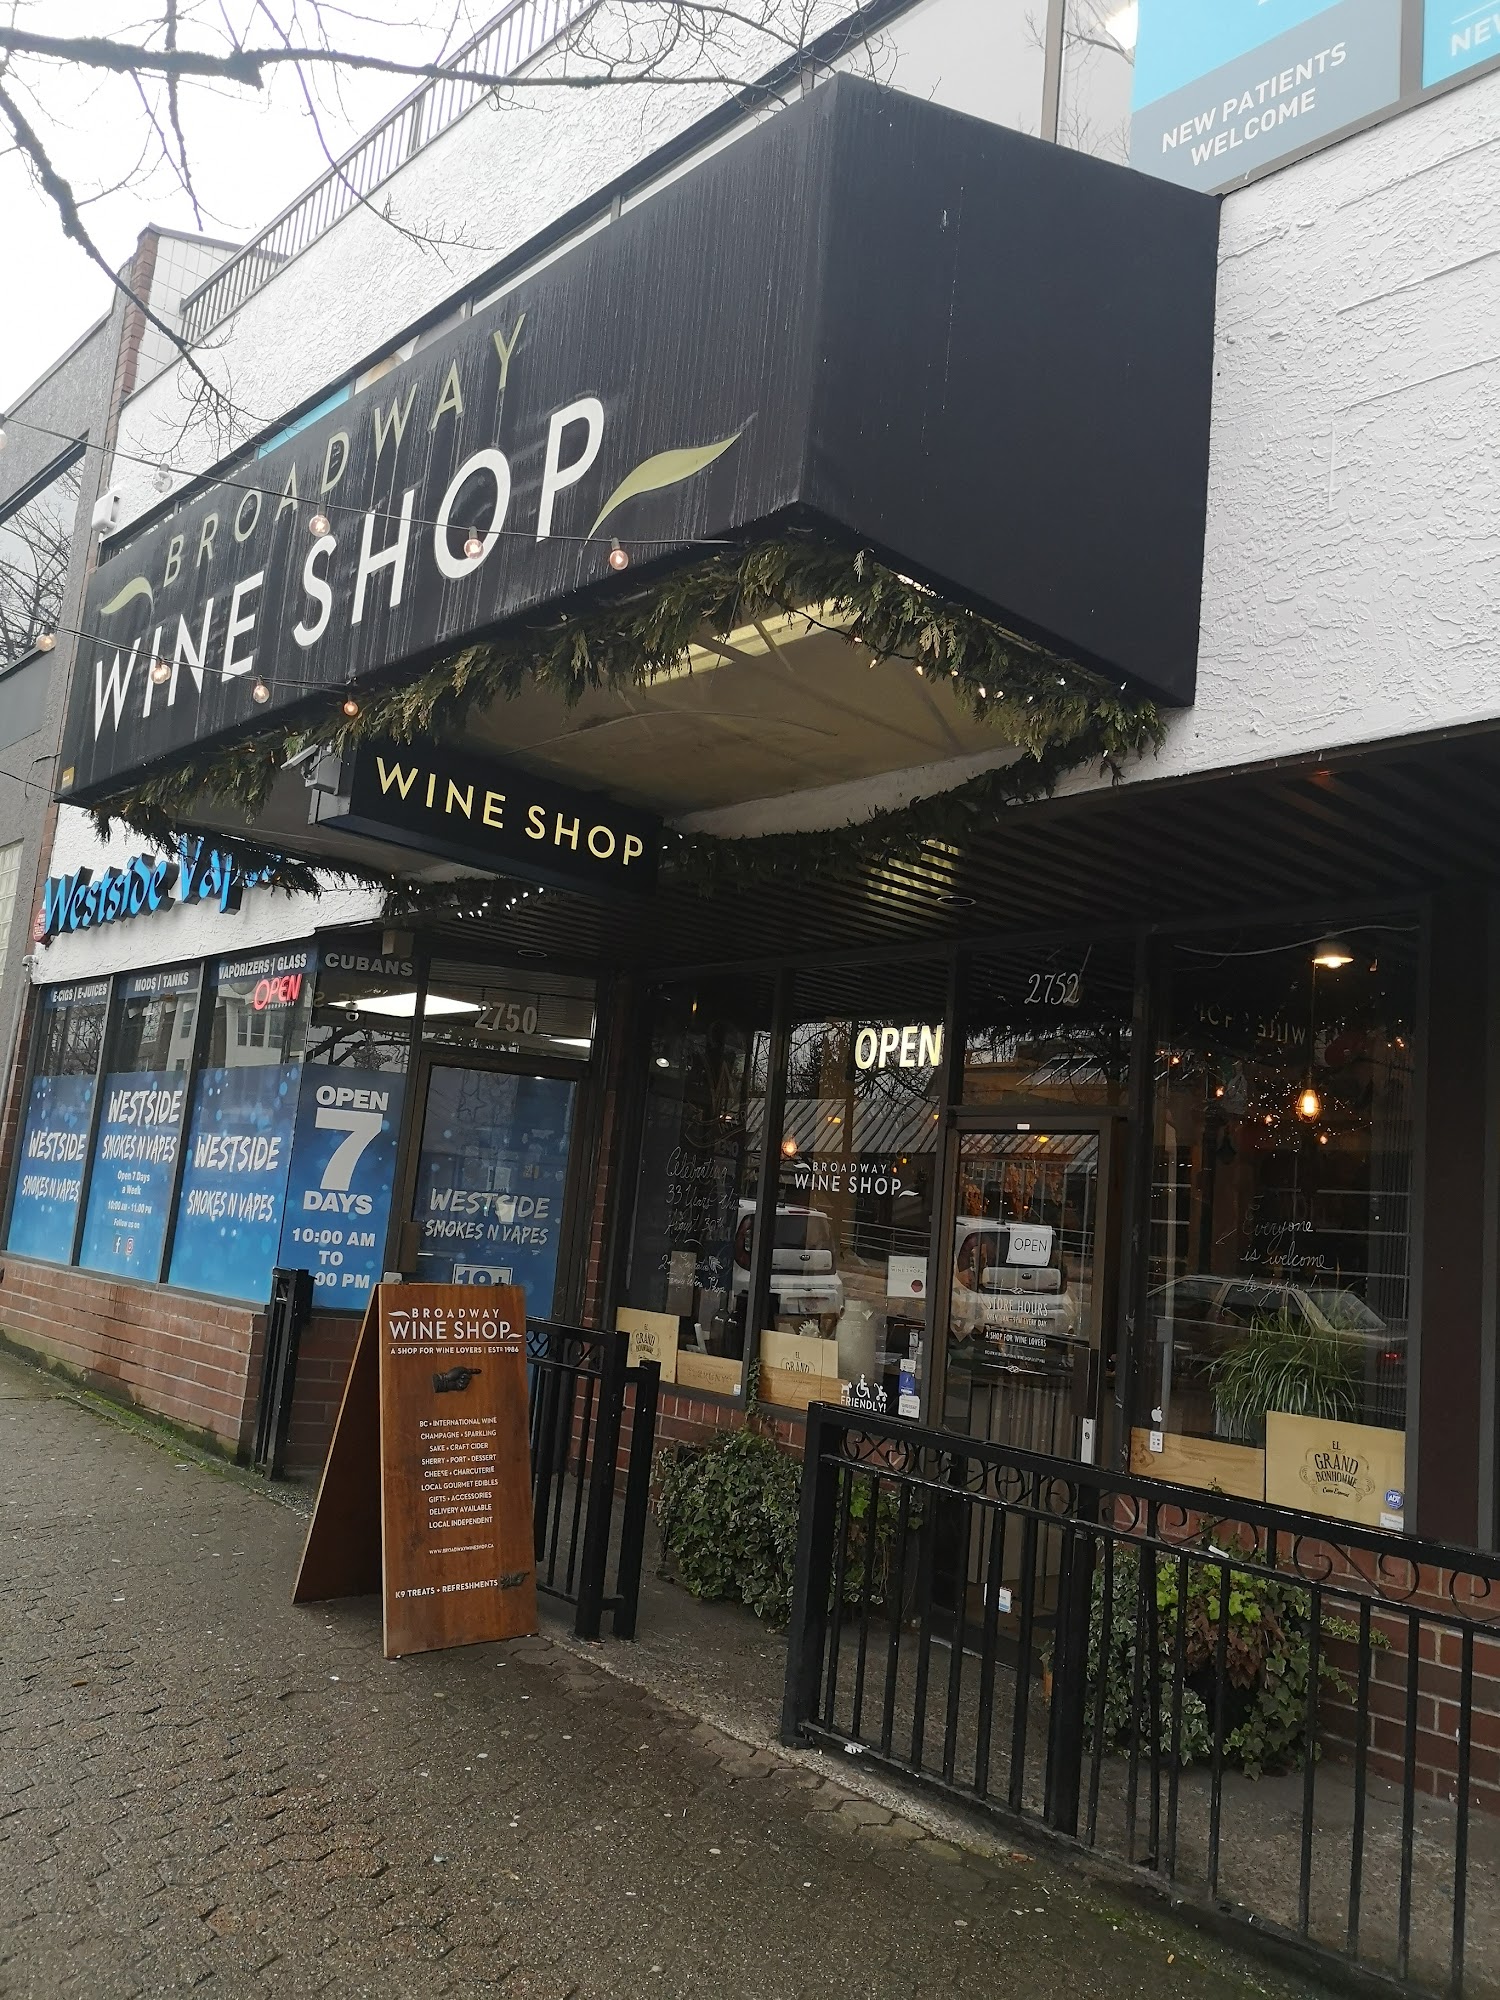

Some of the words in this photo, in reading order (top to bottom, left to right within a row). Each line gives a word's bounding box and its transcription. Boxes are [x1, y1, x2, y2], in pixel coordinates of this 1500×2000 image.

[1161, 108, 1217, 153] NEW
[1222, 42, 1347, 124] PATIENTS
[1190, 88, 1317, 166] WELCOME
[163, 313, 526, 589] BROADWAY
[94, 571, 265, 742] WINE
[293, 397, 605, 647] SHOP
[376, 757, 506, 829] WINE
[525, 805, 644, 865] SHOP
[44, 854, 170, 934] Westside
[219, 959, 270, 979] VAPORIZERS
[277, 953, 307, 971] GLASS
[325, 952, 413, 977] CUBANS
[135, 976, 156, 993] MODS
[163, 972, 189, 988] TANKS
[254, 973, 302, 1010] OPEN
[1025, 972, 1080, 1005] 2752
[474, 1001, 537, 1034] 2750
[854, 1024, 944, 1070] OPEN
[108, 1090, 183, 1127] WESTSIDE
[316, 1085, 390, 1111] OPEN
[28, 1130, 87, 1162] WESTSIDE
[102, 1134, 137, 1160] SMOKES
[136, 1135, 146, 1160] N
[145, 1134, 178, 1165] VAPES
[194, 1134, 282, 1172] WESTSIDE
[314, 1107, 383, 1191] 7
[117, 1170, 131, 1183] Open
[132, 1171, 136, 1180] 7
[136, 1171, 150, 1184] Days
[812, 1161, 887, 1174] BROADWAY
[21, 1174, 50, 1197] SMOKES
[48, 1178, 57, 1198] N
[54, 1178, 81, 1203] VAPES
[126, 1184, 142, 1195] Week
[794, 1173, 841, 1192] WINE
[848, 1176, 902, 1196] SHOP
[187, 1189, 228, 1218] SMOKES
[227, 1192, 238, 1218] N
[238, 1192, 275, 1223] VAPES
[303, 1190, 374, 1216] DAYS
[430, 1188, 551, 1219] WESTSIDE
[292, 1227, 343, 1245] 10:00
[346, 1231, 376, 1247] AM
[425, 1219, 484, 1241] SMOKES
[487, 1222, 499, 1241] N
[503, 1220, 549, 1245] VAPES
[1014, 1238, 1048, 1252] OPEN
[1240, 1244, 1261, 1261] is
[1261, 1240, 1334, 1270] welcome
[318, 1250, 344, 1266] TO
[342, 1273, 370, 1289] PM
[411, 1308, 500, 1318] BROADWAY
[1017, 1300, 1048, 1317] HOURS
[389, 1321, 447, 1340] WINE
[453, 1321, 511, 1340] SHOP
[990, 1331, 1004, 1340] SHOP
[1003, 1333, 1014, 1342] FOR
[390, 1347, 396, 1355] A
[840, 1395, 887, 1413] FRIENDLY!
[420, 1420, 428, 1428] BC
[433, 1417, 480, 1427] INTERNATIONAL
[482, 1417, 497, 1425] WINE
[420, 1431, 459, 1440] CHAMPAGNE
[464, 1430, 496, 1438] SPARKLING
[1332, 1440, 1341, 1450] EL
[429, 1444, 446, 1452] SAKE
[450, 1443, 469, 1451] CRAFT
[471, 1442, 488, 1450] CIDER
[421, 1457, 445, 1466] SHERRY
[450, 1456, 466, 1464] PORT
[471, 1454, 496, 1462] DESSERT
[1314, 1453, 1359, 1475] GRAND
[424, 1469, 448, 1478] CHEESE
[453, 1466, 495, 1476] CHARCUTERIE
[1315, 1470, 1358, 1489] BONHOMME
[421, 1483, 442, 1491] LOCAL
[443, 1481, 473, 1490] GOURMET
[474, 1479, 498, 1487] EDIBLES
[429, 1496, 447, 1504] GIFTS
[451, 1492, 492, 1501] ACCESSORIES
[429, 1507, 458, 1516] DELIVERY
[460, 1504, 492, 1513] AVAILABLE
[429, 1521, 450, 1529] LOCAL
[451, 1516, 493, 1526] INDEPENDENT
[395, 1590, 405, 1599] K9
[407, 1587, 435, 1597] TREATS
[442, 1579, 498, 1593] REFRESHMENTS
